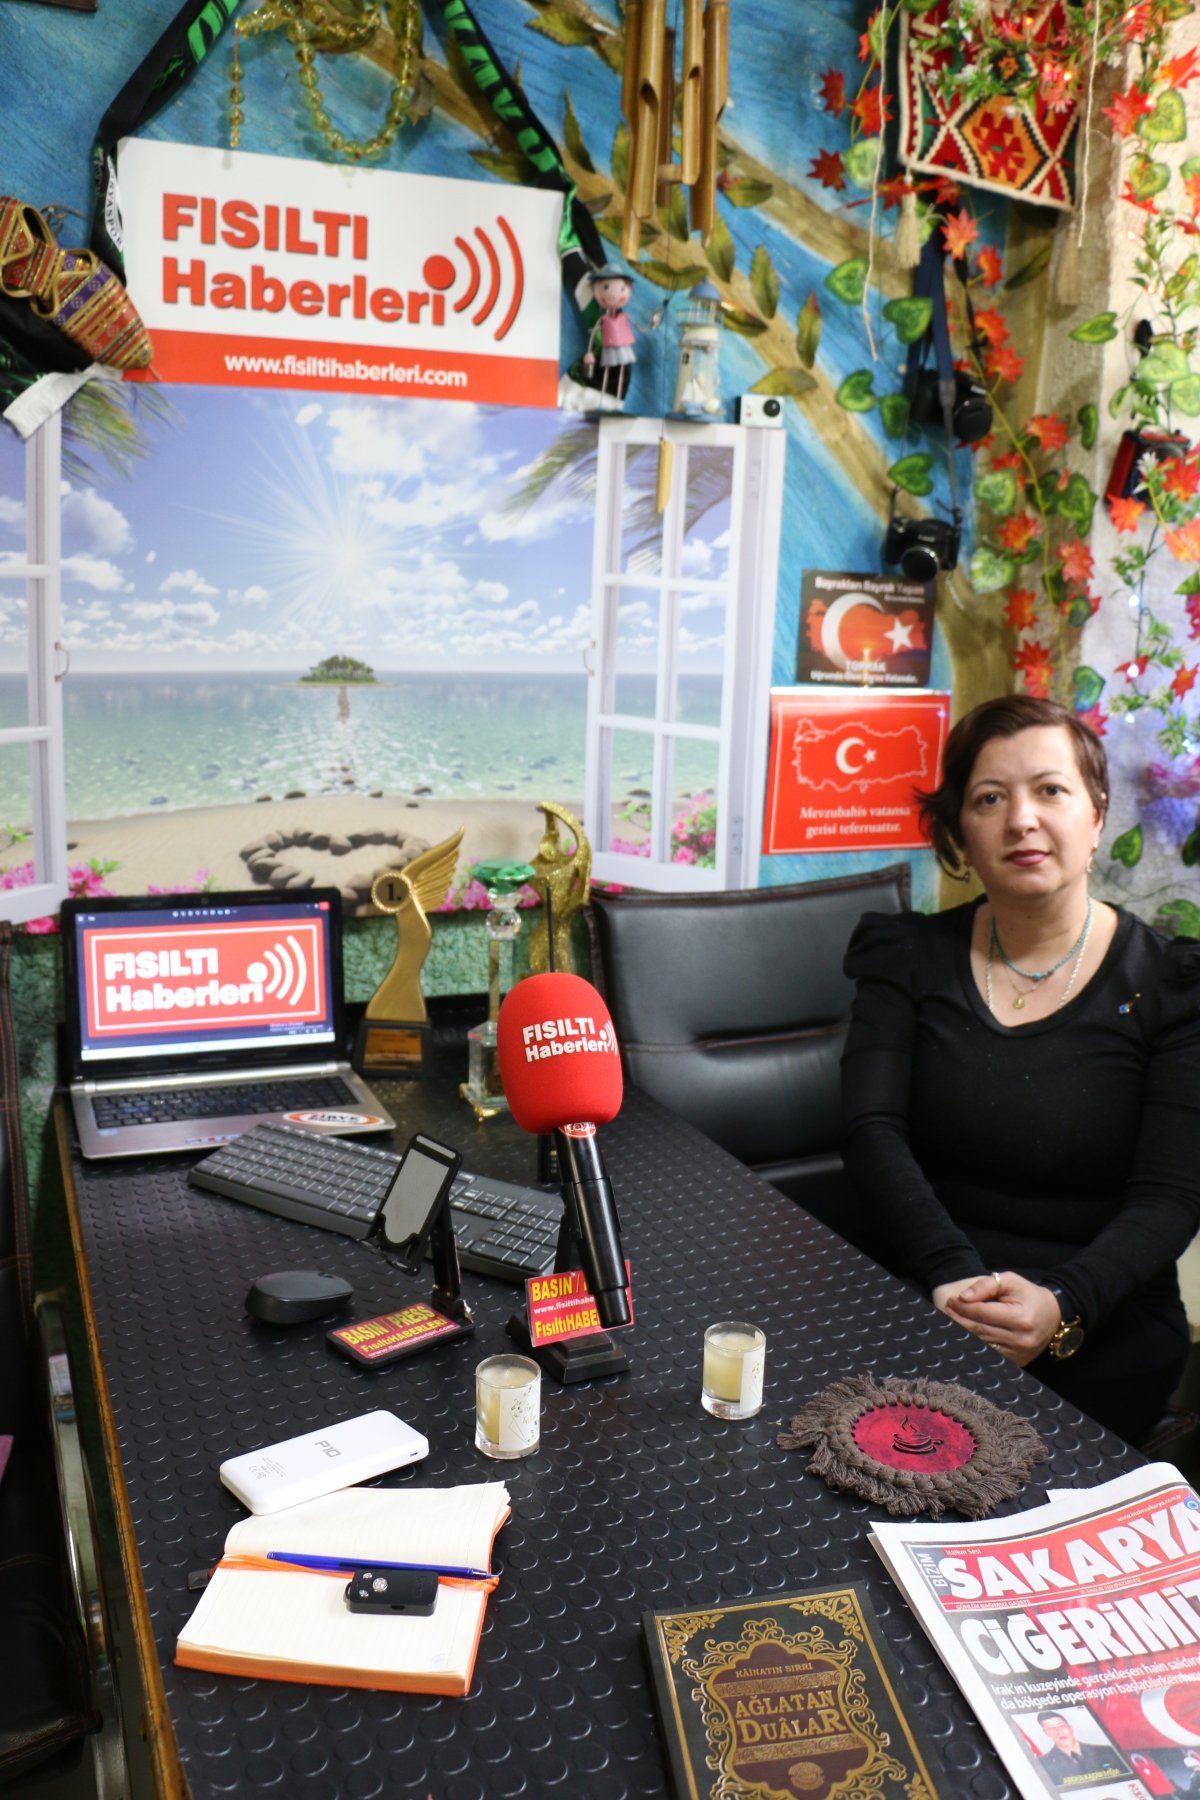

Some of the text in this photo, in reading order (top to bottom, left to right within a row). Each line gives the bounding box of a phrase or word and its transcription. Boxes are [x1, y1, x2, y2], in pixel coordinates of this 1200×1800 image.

[163, 193, 368, 260] FISILTI
[162, 256, 446, 327] Haberleri
[224, 355, 468, 388] www.fisiltihaberleri.com
[800, 806, 911, 819] Mevzubahis vatansa
[805, 823, 837, 840] gerisi
[104, 948, 219, 981] FISILTI
[105, 979, 264, 1013] Haberleri
[522, 1017, 596, 1046] FISILTI
[525, 1036, 608, 1063] Haberleri
[531, 1275, 573, 1303] BASIN
[533, 1296, 595, 1315] www.fisiltihabe
[340, 1321, 390, 1345] BASIN
[387, 1305, 436, 1329] PRESS
[534, 1308, 601, 1339] FısıltıHABE
[314, 1440, 342, 1458] P10
[916, 1552, 949, 1587] BİZİM
[784, 1663, 813, 1673] SIRRI
[1024, 1675, 1082, 1693] kuzeyinde
[1081, 1667, 1144, 1688] gerçekleşen
[1141, 1661, 1168, 1676] hain
[735, 1690, 835, 1719] AĞLATAN
[1000, 1698, 1018, 1710] da
[1013, 1692, 1062, 1709] bölgede
[1060, 1684, 1118, 1704] operasyon
[736, 1708, 847, 1744] DUÂLAR
